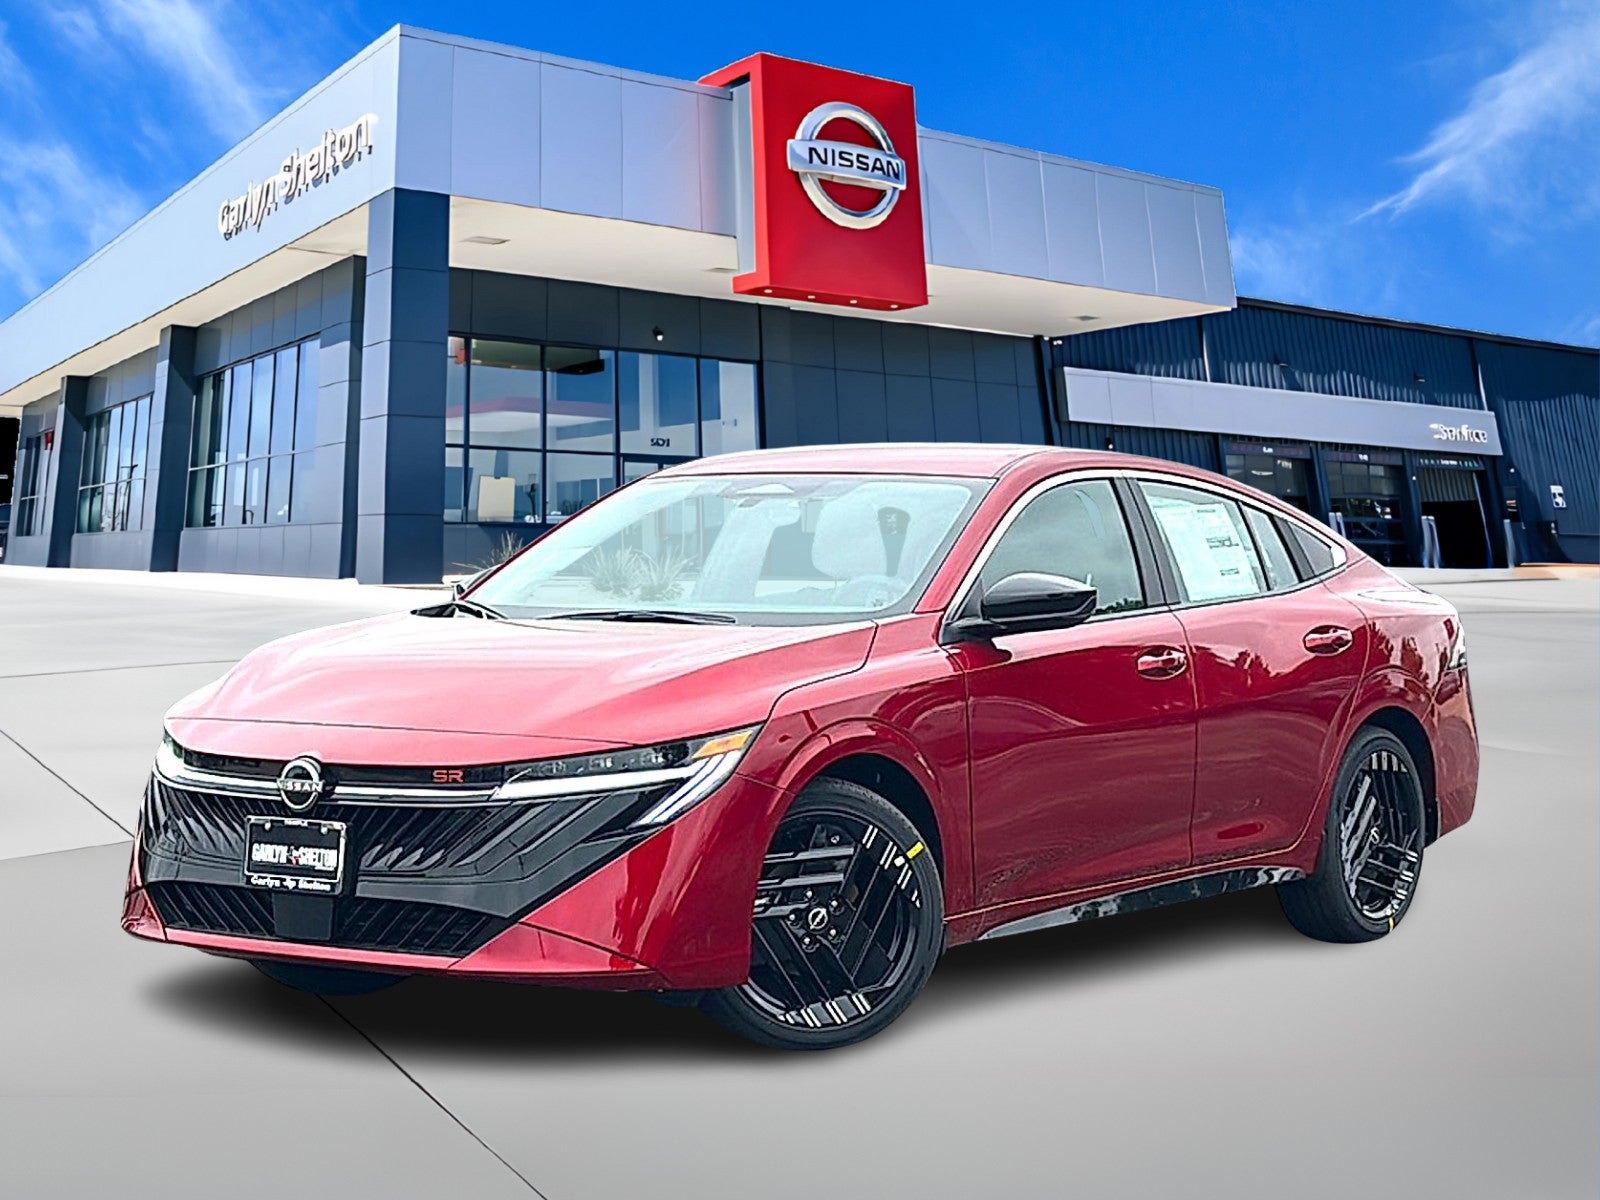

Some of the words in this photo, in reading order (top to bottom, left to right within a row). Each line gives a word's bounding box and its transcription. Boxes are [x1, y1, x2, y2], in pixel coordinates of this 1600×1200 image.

[279, 115, 375, 202] Shelton
[807, 146, 900, 181] NISSAN
[432, 769, 464, 783] SR
